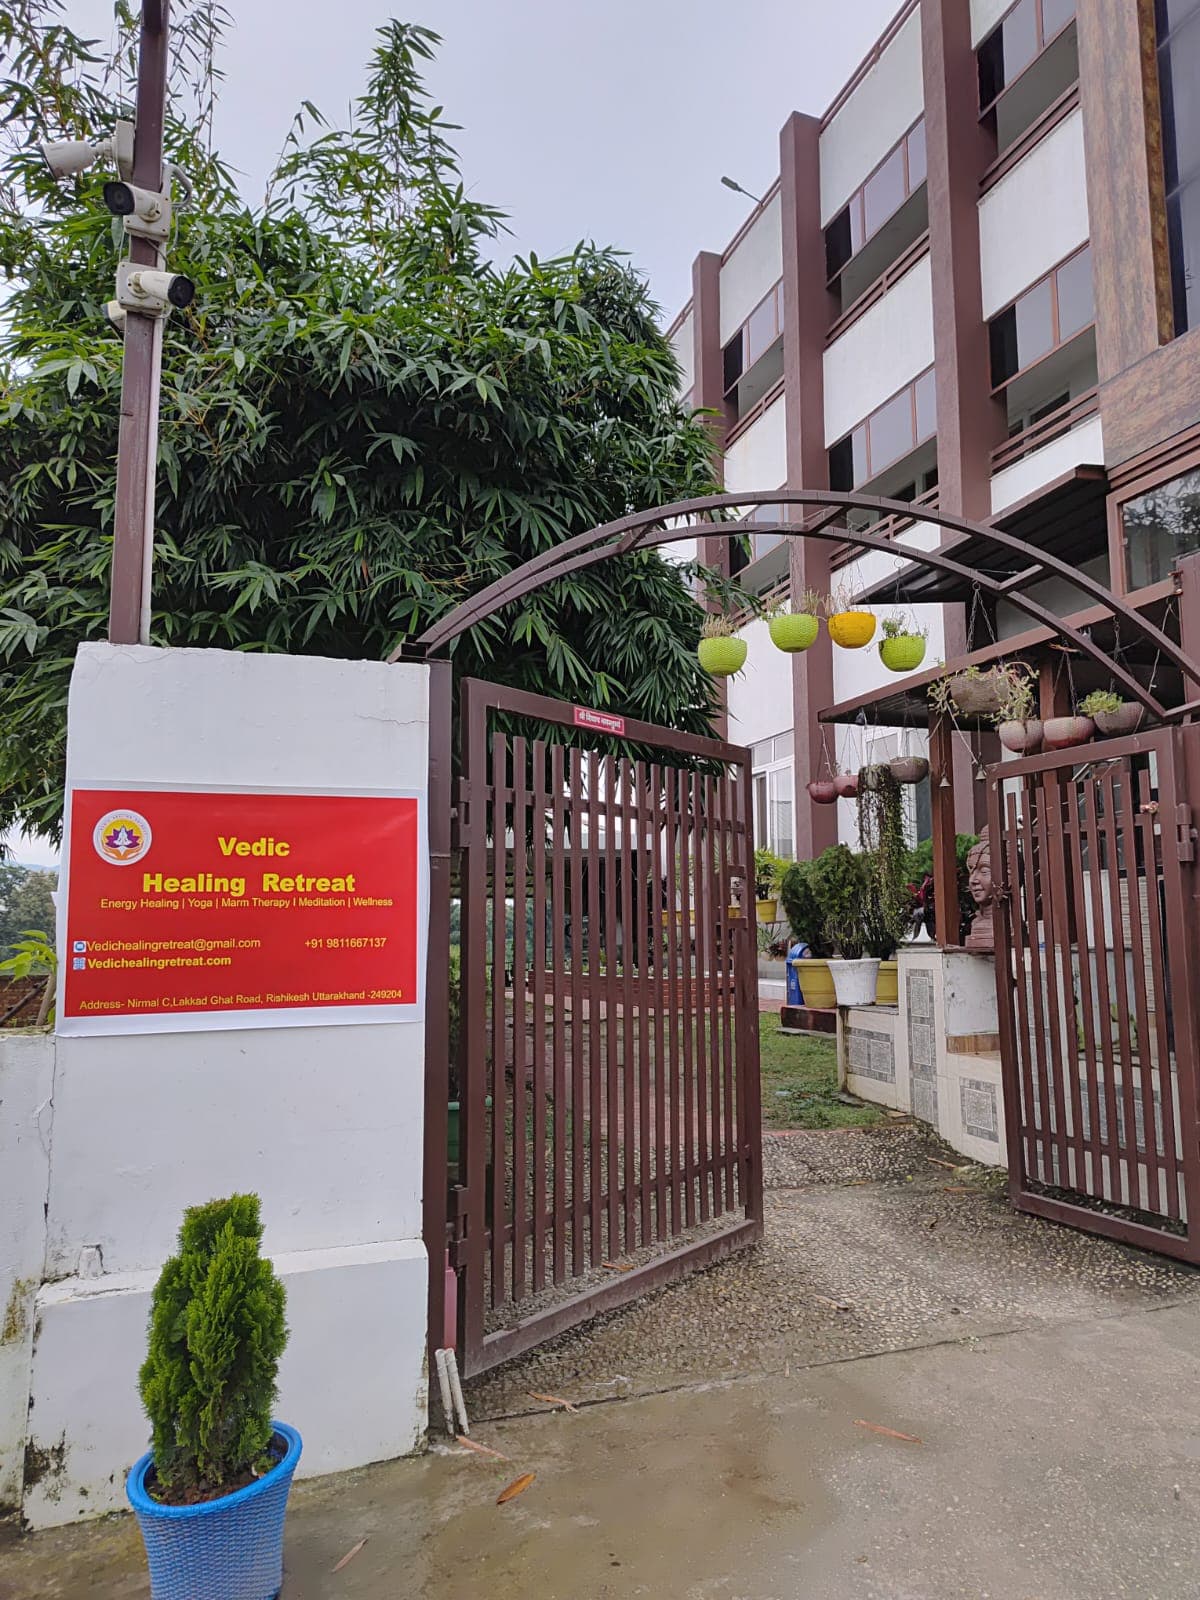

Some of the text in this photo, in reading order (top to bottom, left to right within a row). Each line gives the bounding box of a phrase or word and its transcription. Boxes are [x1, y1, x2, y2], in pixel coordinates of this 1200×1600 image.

[218, 837, 290, 856] Vedic
[143, 873, 356, 897] Healing Retreat
[101, 898, 138, 910] Energy
[140, 898, 179, 910] Healing
[188, 898, 213, 910] Yoga
[221, 898, 249, 908] Marm
[252, 897, 291, 909] Therapy
[298, 897, 345, 907] Meditation
[353, 897, 393, 907] Wellness
[87, 938, 261, 952] Vedichealingretreat@gmail.com
[304, 937, 387, 949] +91 9811667137
[88, 957, 232, 970] Vedichealingretreat.com
[79, 1000, 125, 1010] Address-
[127, 998, 159, 1008] Nirmal
[210, 995, 234, 1005] Ghat
[236, 994, 263, 1005] Road,
[266, 993, 310, 1003] Rishikesh
[312, 991, 365, 1001] Uttarakhand
